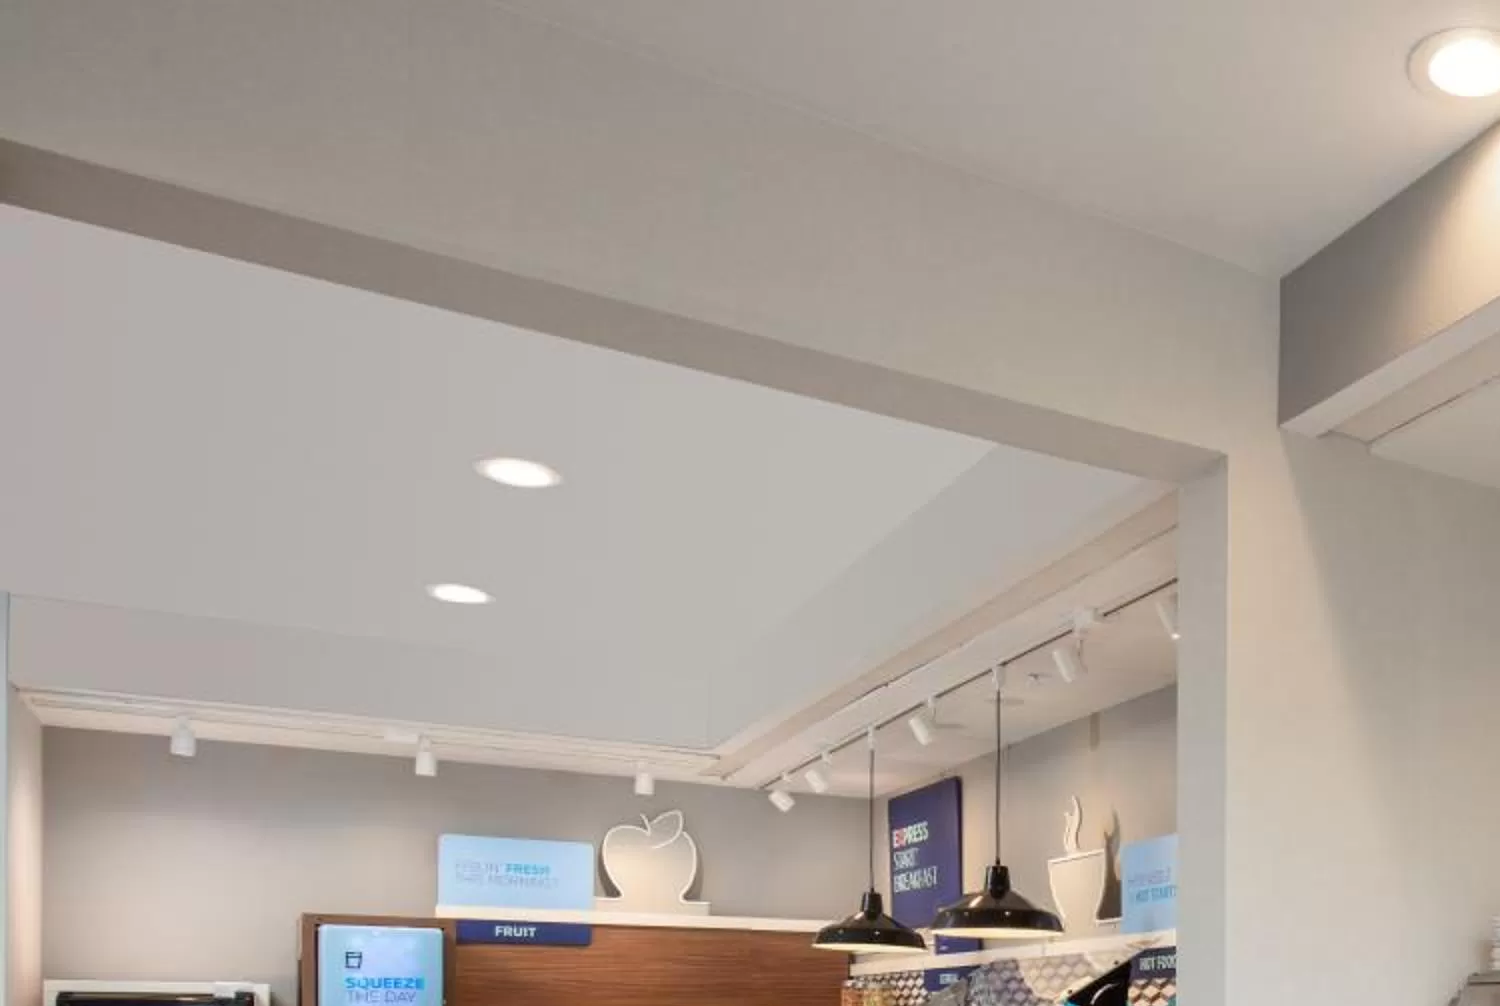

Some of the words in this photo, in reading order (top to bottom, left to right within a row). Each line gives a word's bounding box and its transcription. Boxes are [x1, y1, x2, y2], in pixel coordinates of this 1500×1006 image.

[494, 925, 537, 938] FRUIT
[344, 977, 425, 990] SQUEEZE
[347, 990, 380, 1003] THE
[384, 990, 417, 1003] DAY
